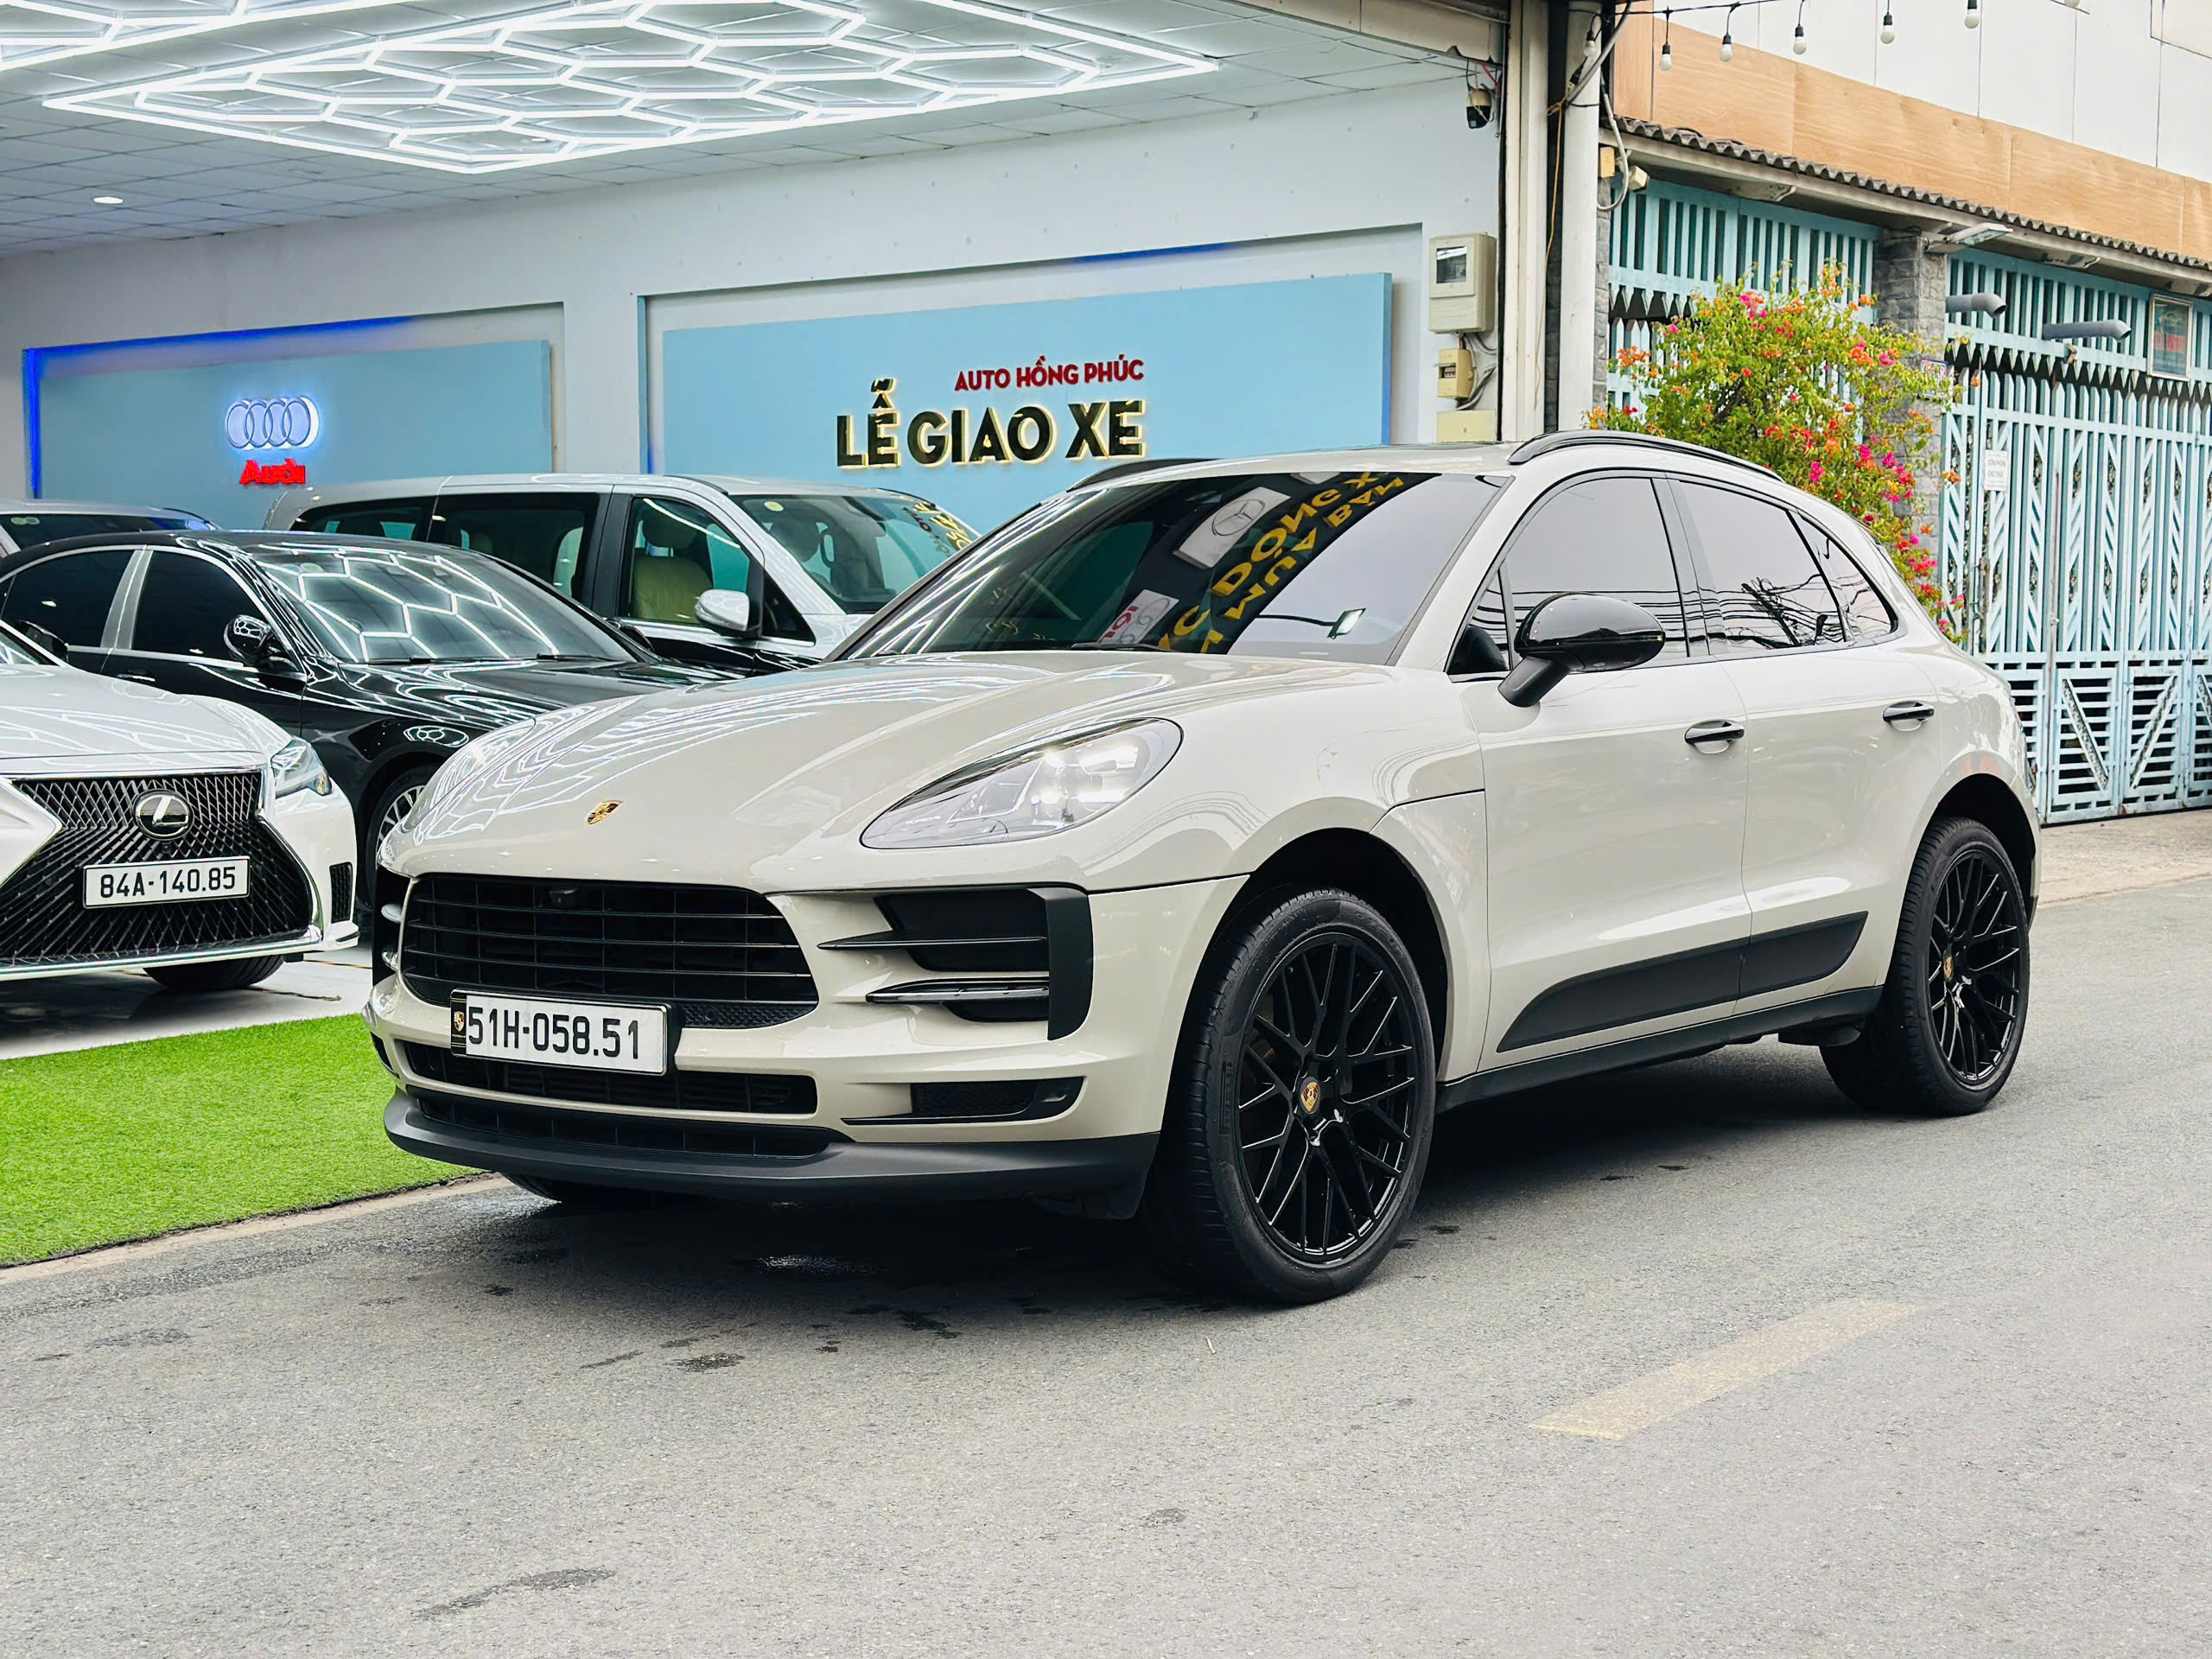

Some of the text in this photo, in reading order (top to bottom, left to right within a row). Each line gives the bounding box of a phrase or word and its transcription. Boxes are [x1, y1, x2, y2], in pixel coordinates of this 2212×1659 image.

[955, 353, 1145, 391] AUTO HỒNG PHÚC
[836, 378, 1146, 467] LỄ GIAO XE
[239, 458, 306, 485] Audi
[100, 867, 236, 899] 84A-140.85
[468, 1006, 639, 1059] 51H-058.51
